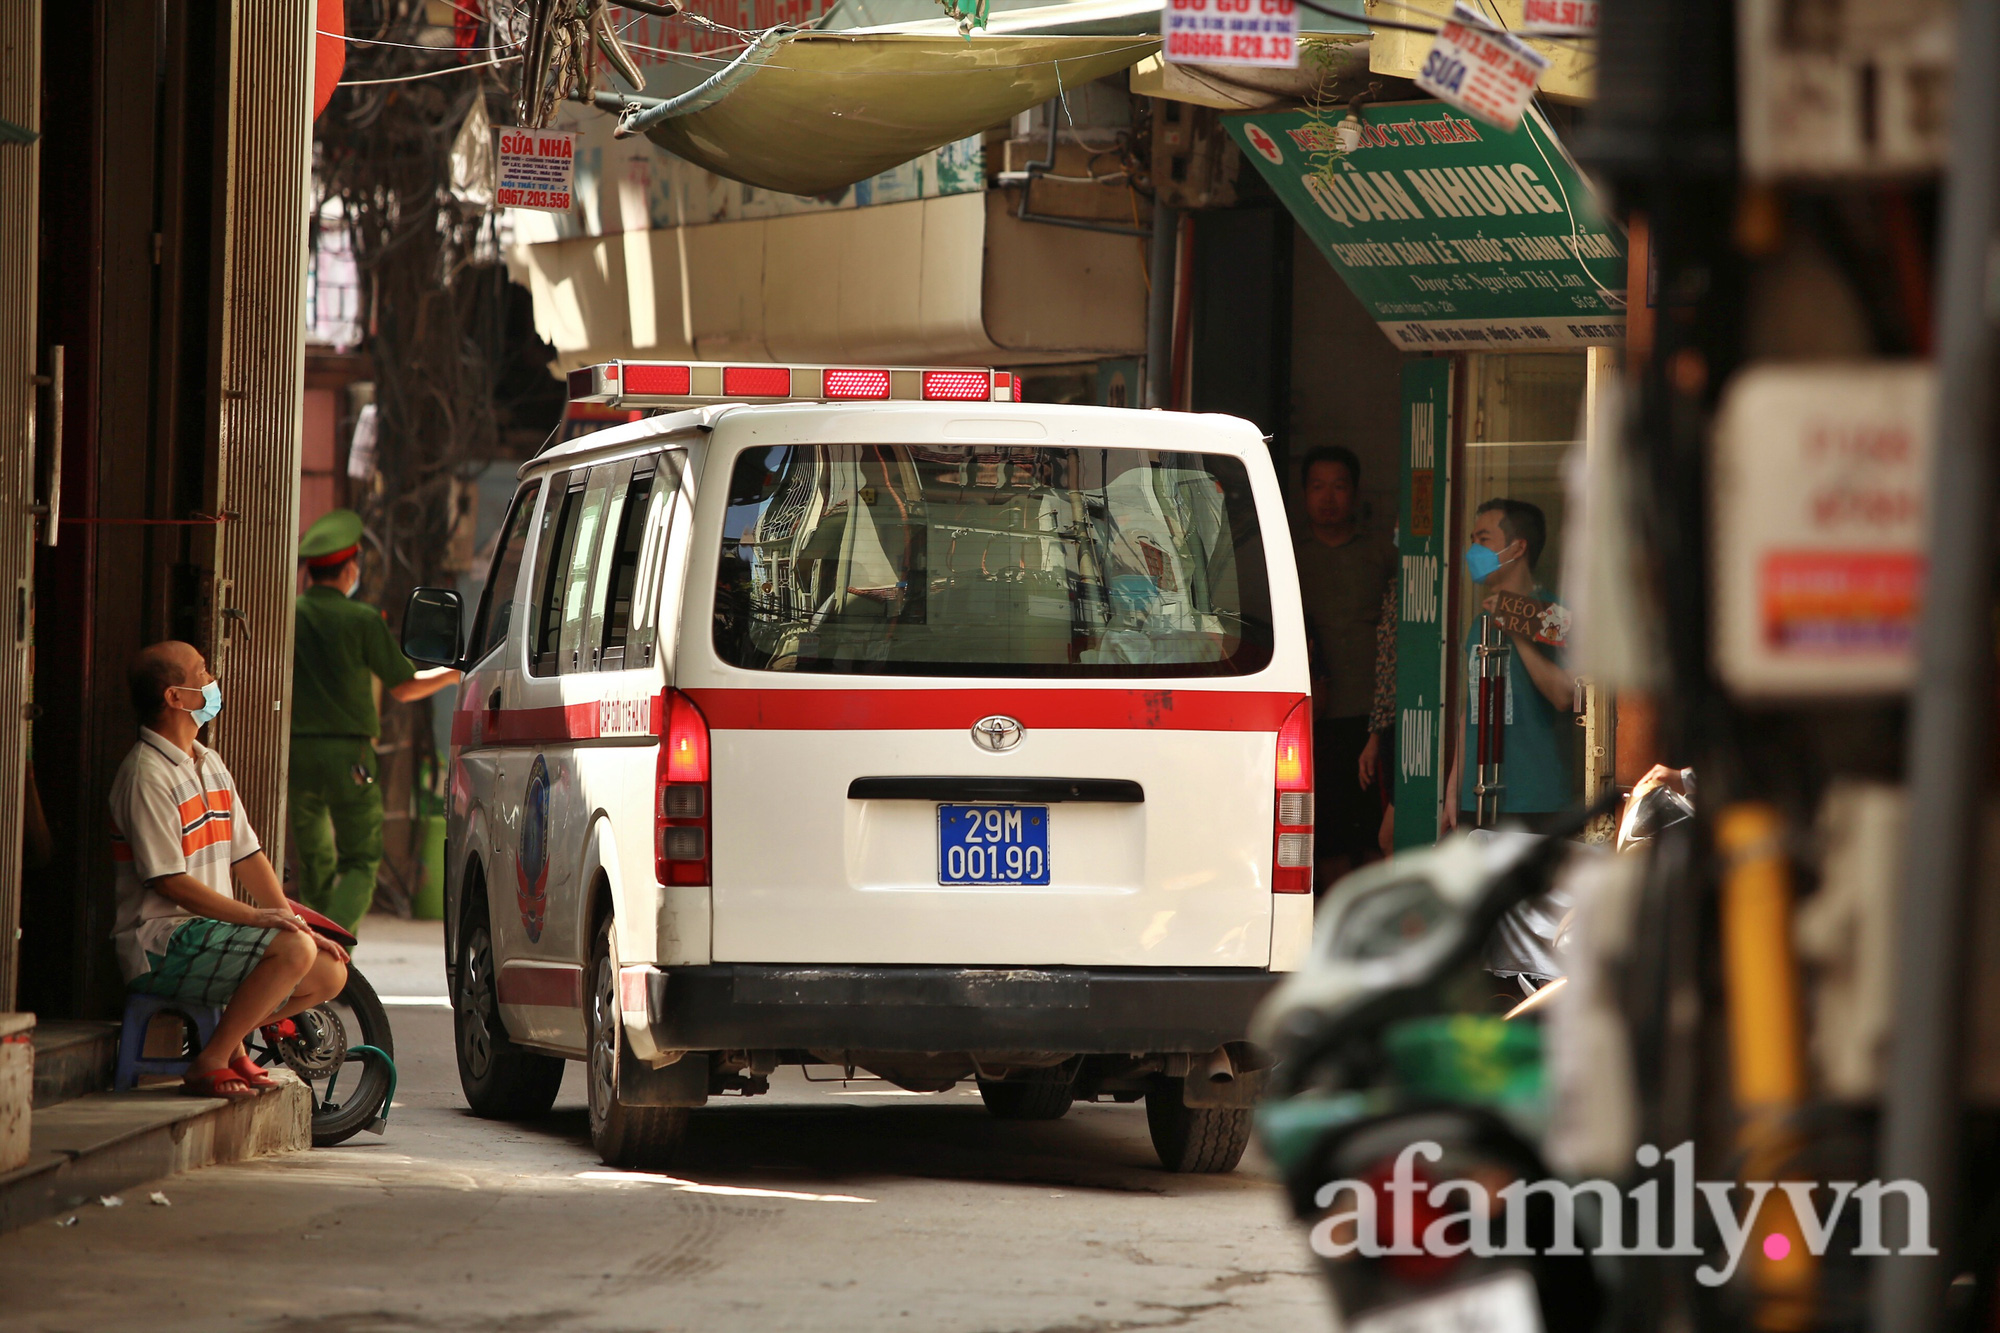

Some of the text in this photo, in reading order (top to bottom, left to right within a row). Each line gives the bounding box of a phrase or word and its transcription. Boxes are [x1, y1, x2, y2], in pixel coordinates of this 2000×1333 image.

[501, 131, 572, 158] SỬA NHÀ
[1286, 128, 1337, 151] NH
[1390, 118, 1425, 146] TƯ
[1419, 112, 1483, 145] NHÂN
[497, 188, 570, 209] 0967.203.558
[518, 181, 535, 189] THẤT
[1301, 162, 1564, 228] QUÂN NHUNG
[1332, 224, 1622, 267] CHUYÊN BÁN LẺ THUỐC THÀNH PHẨM
[1409, 275, 1454, 296] Dược
[1467, 267, 1528, 294] Nguyễn
[1520, 270, 1559, 292] Thị
[1548, 270, 1586, 288] Lan
[1411, 387, 1435, 468] NHÀ
[1402, 535, 1438, 623] THUỐC
[1501, 597, 1536, 619] KÉO
[1509, 617, 1532, 636] RA
[622, 700, 631, 732] 115
[1401, 695, 1432, 784] QUÂN
[965, 809, 1022, 843] 29M
[948, 845, 1043, 880] 001.90
